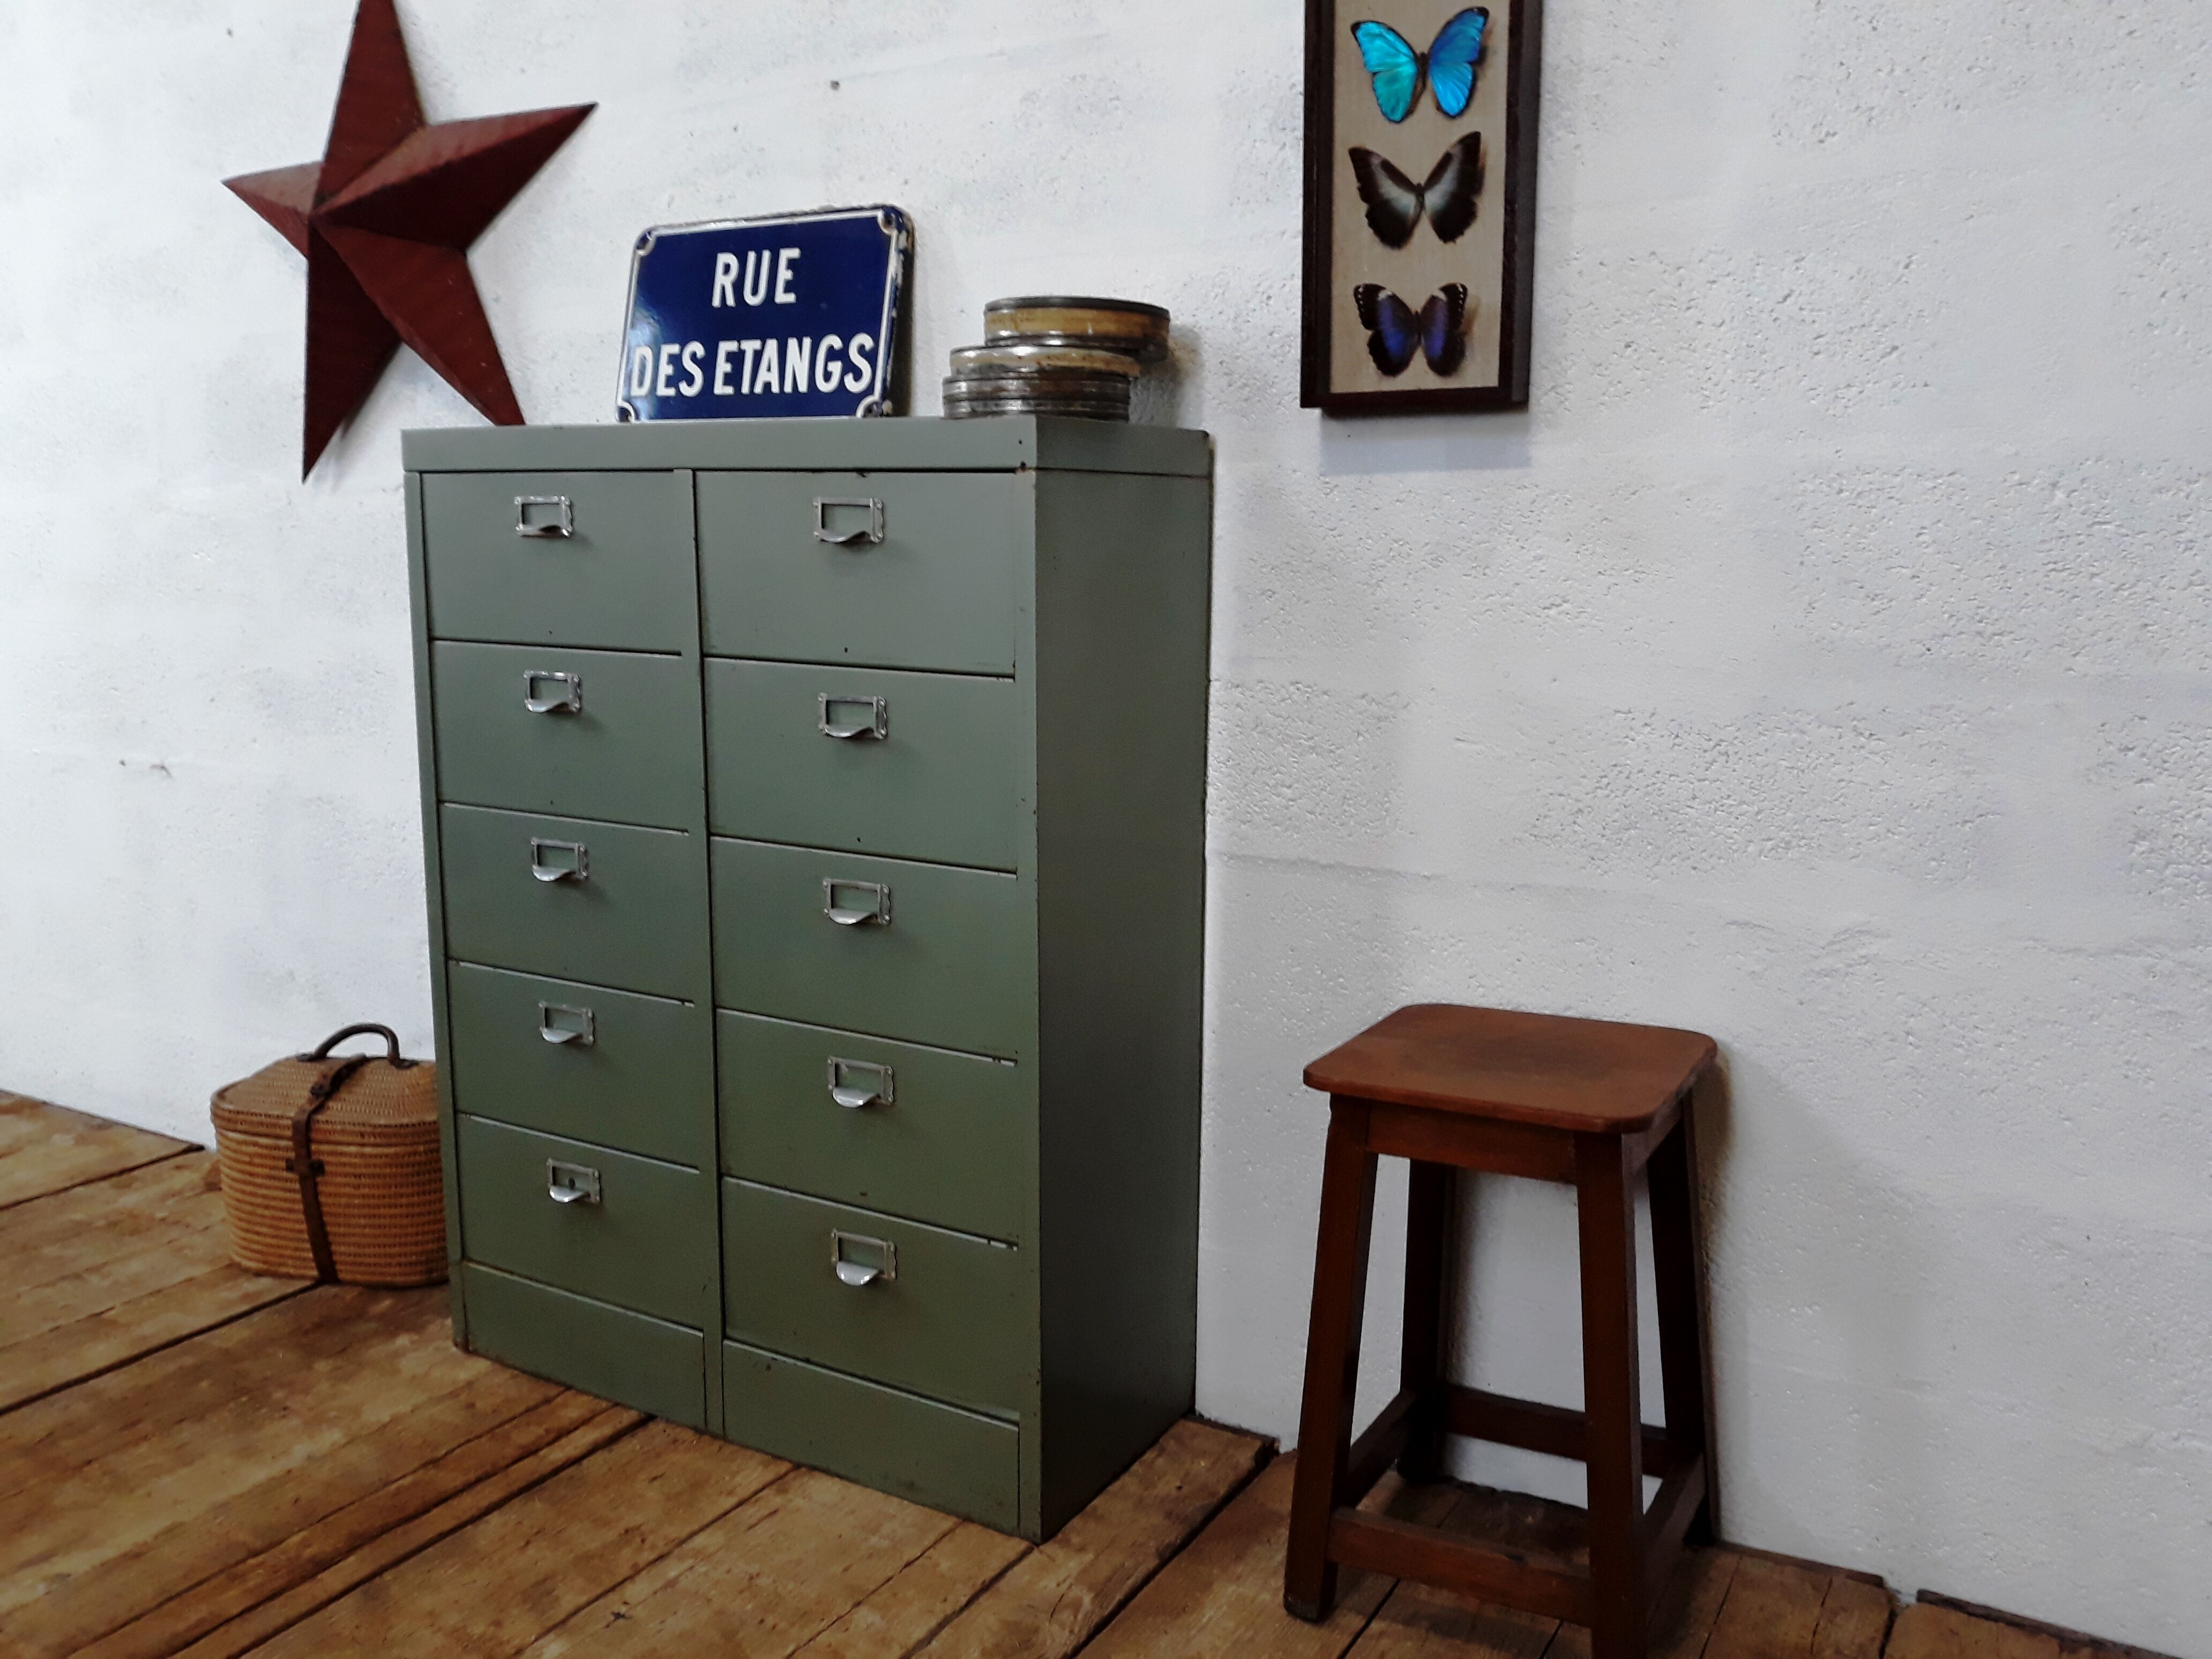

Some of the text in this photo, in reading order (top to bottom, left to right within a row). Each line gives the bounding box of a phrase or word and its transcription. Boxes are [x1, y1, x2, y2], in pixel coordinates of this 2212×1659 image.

[712, 247, 801, 308] RUE
[630, 332, 875, 398] DES ETANGS
